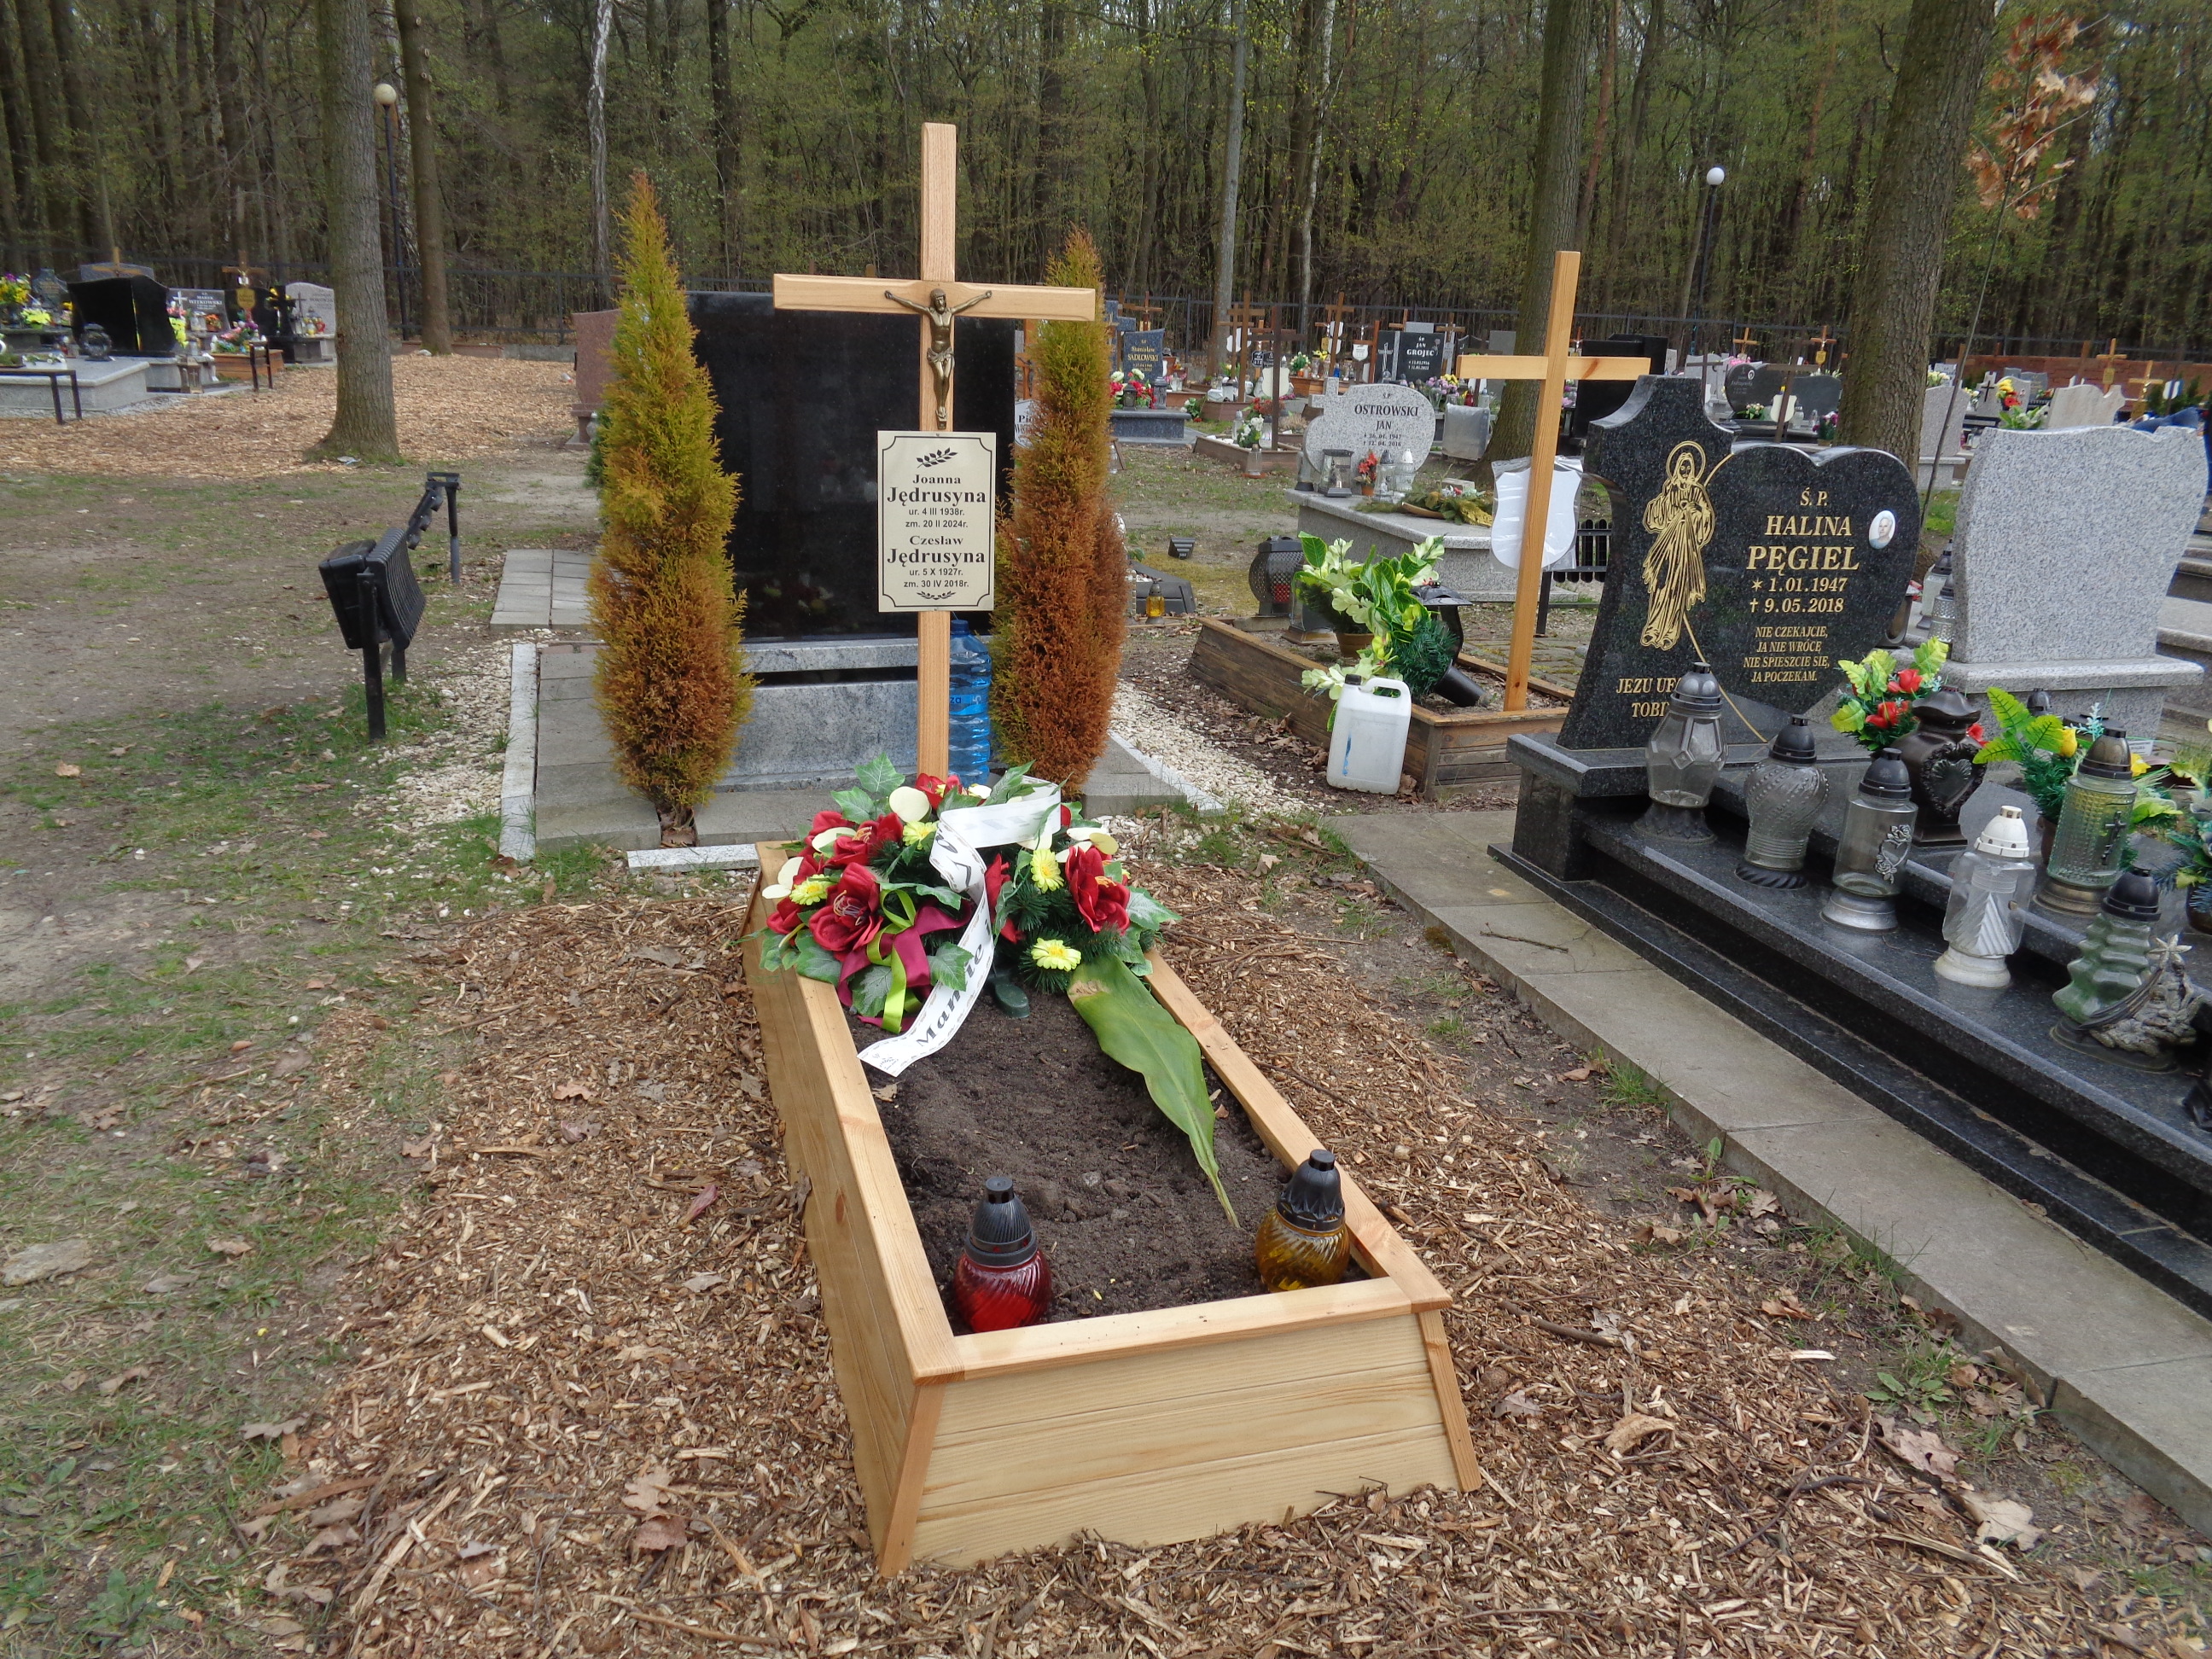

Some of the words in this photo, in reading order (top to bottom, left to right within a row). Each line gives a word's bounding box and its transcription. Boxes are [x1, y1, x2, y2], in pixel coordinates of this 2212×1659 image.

[1406, 349, 1435, 358] GROJEC
[1354, 404, 1419, 416] OSTROWSKI
[1376, 420, 1392, 431] JAN
[912, 474, 961, 484] Joanna
[887, 487, 986, 506] Jędrusyna
[1764, 515, 1852, 536] HALINA
[887, 549, 986, 567] Jędrusyna
[1746, 545, 1860, 576] PĘGIEL
[1755, 626, 1773, 637] NIE
[1775, 626, 1828, 638] CZEKAJCIE,
[1756, 642, 1767, 653] JA
[1769, 641, 1787, 652] NIE
[1789, 638, 1822, 654] WRÓCĘ
[1743, 657, 1761, 667] NIE
[1762, 656, 1811, 667] SPIESZCIE
[1813, 655, 1830, 669] SIĘ,
[1751, 672, 1761, 683] JA
[1763, 671, 1817, 683] POCZEKAM.
[1615, 678, 1654, 694] JEZU
[1632, 701, 1669, 718] TOBI
